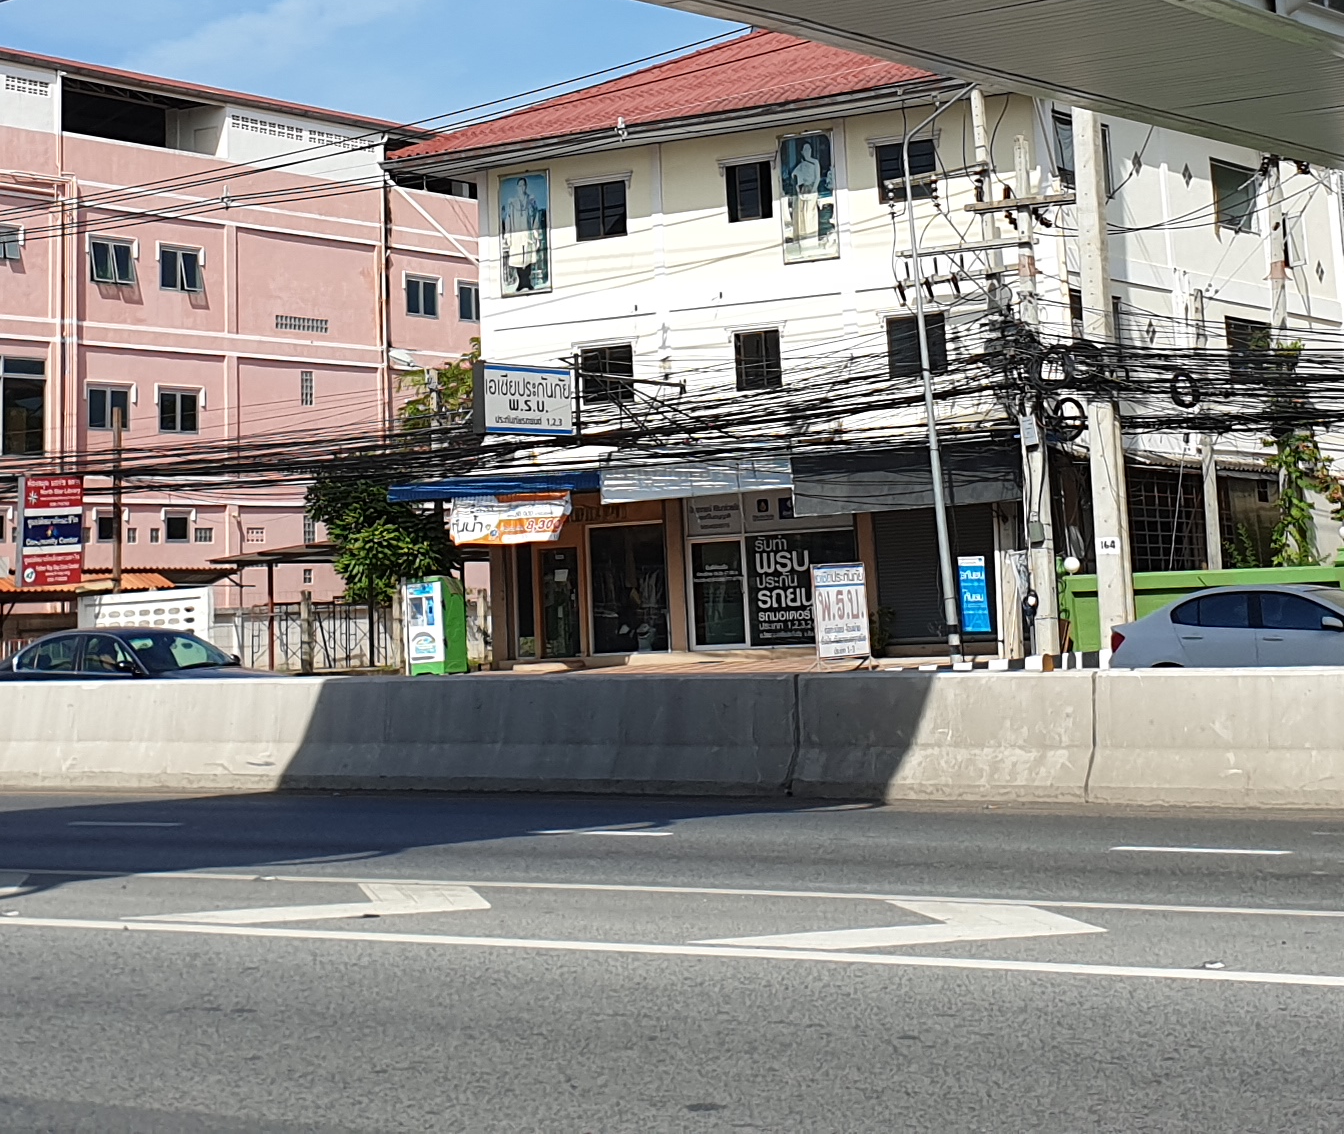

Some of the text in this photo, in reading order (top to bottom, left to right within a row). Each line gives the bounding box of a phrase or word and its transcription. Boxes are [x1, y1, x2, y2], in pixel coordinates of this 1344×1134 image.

[485, 373, 570, 400] เอเชียประกันภัย
[509, 398, 549, 414] พ.ร.บ.
[755, 535, 788, 551] รับทำ
[755, 550, 809, 574] พรบ
[756, 572, 798, 588] ประกัน
